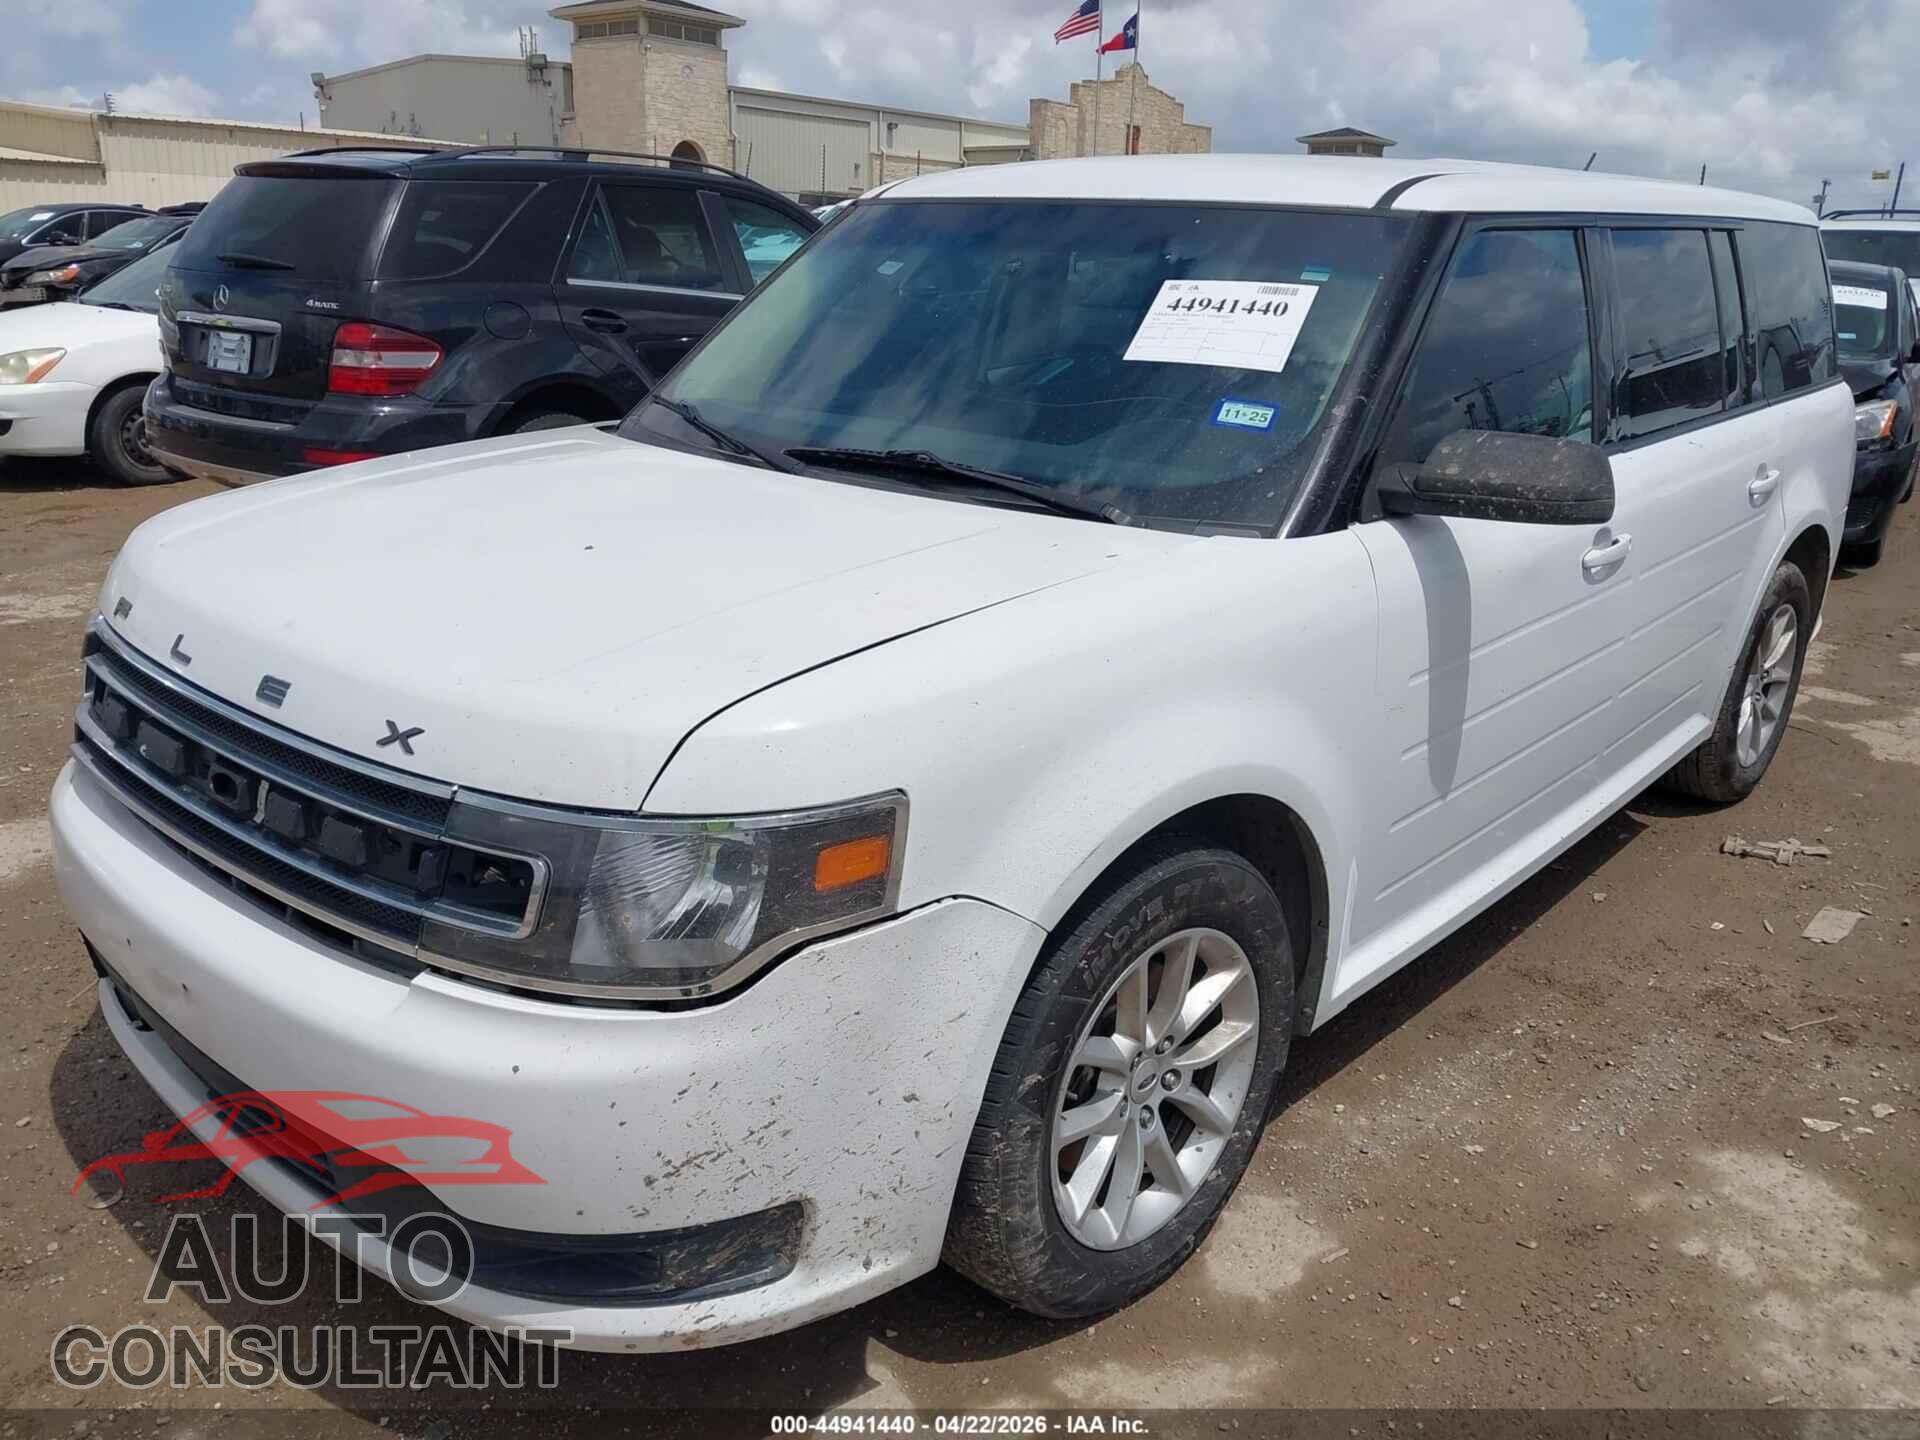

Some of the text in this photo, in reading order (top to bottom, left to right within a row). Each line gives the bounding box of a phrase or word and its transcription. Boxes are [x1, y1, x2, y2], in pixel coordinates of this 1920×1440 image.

[1167, 296, 1289, 317] 44941440
[1224, 408, 1269, 423] 11 25
